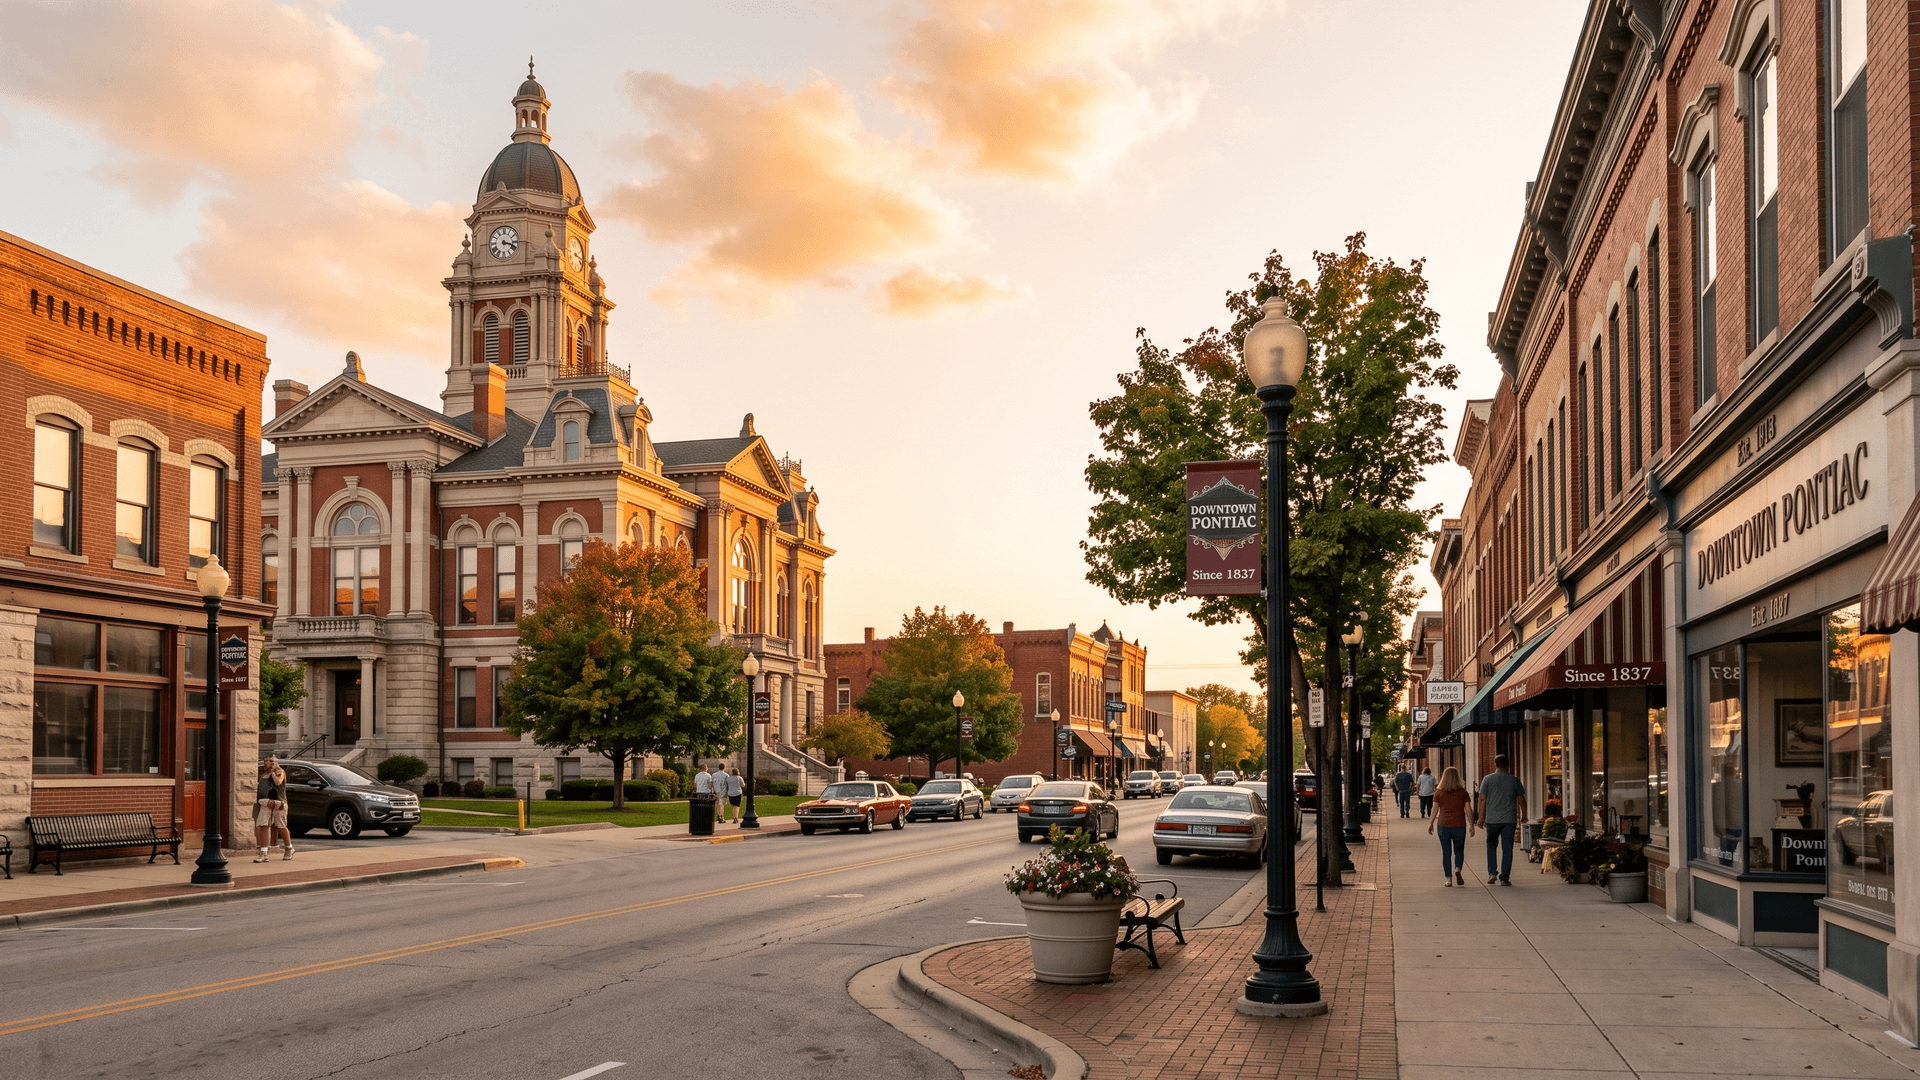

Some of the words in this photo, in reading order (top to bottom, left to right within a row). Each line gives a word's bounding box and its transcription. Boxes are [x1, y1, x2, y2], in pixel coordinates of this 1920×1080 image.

[1191, 504, 1257, 515] DOWNTOWN
[1697, 501, 1777, 590] DOWNTOWN
[1781, 440, 1869, 543] PONTIAC
[1191, 515, 1257, 529] PONTIAC
[1192, 570, 1223, 580] Since
[1227, 569, 1256, 580] 1837
[1565, 669, 1605, 682] Since
[1611, 666, 1652, 681] 1837
